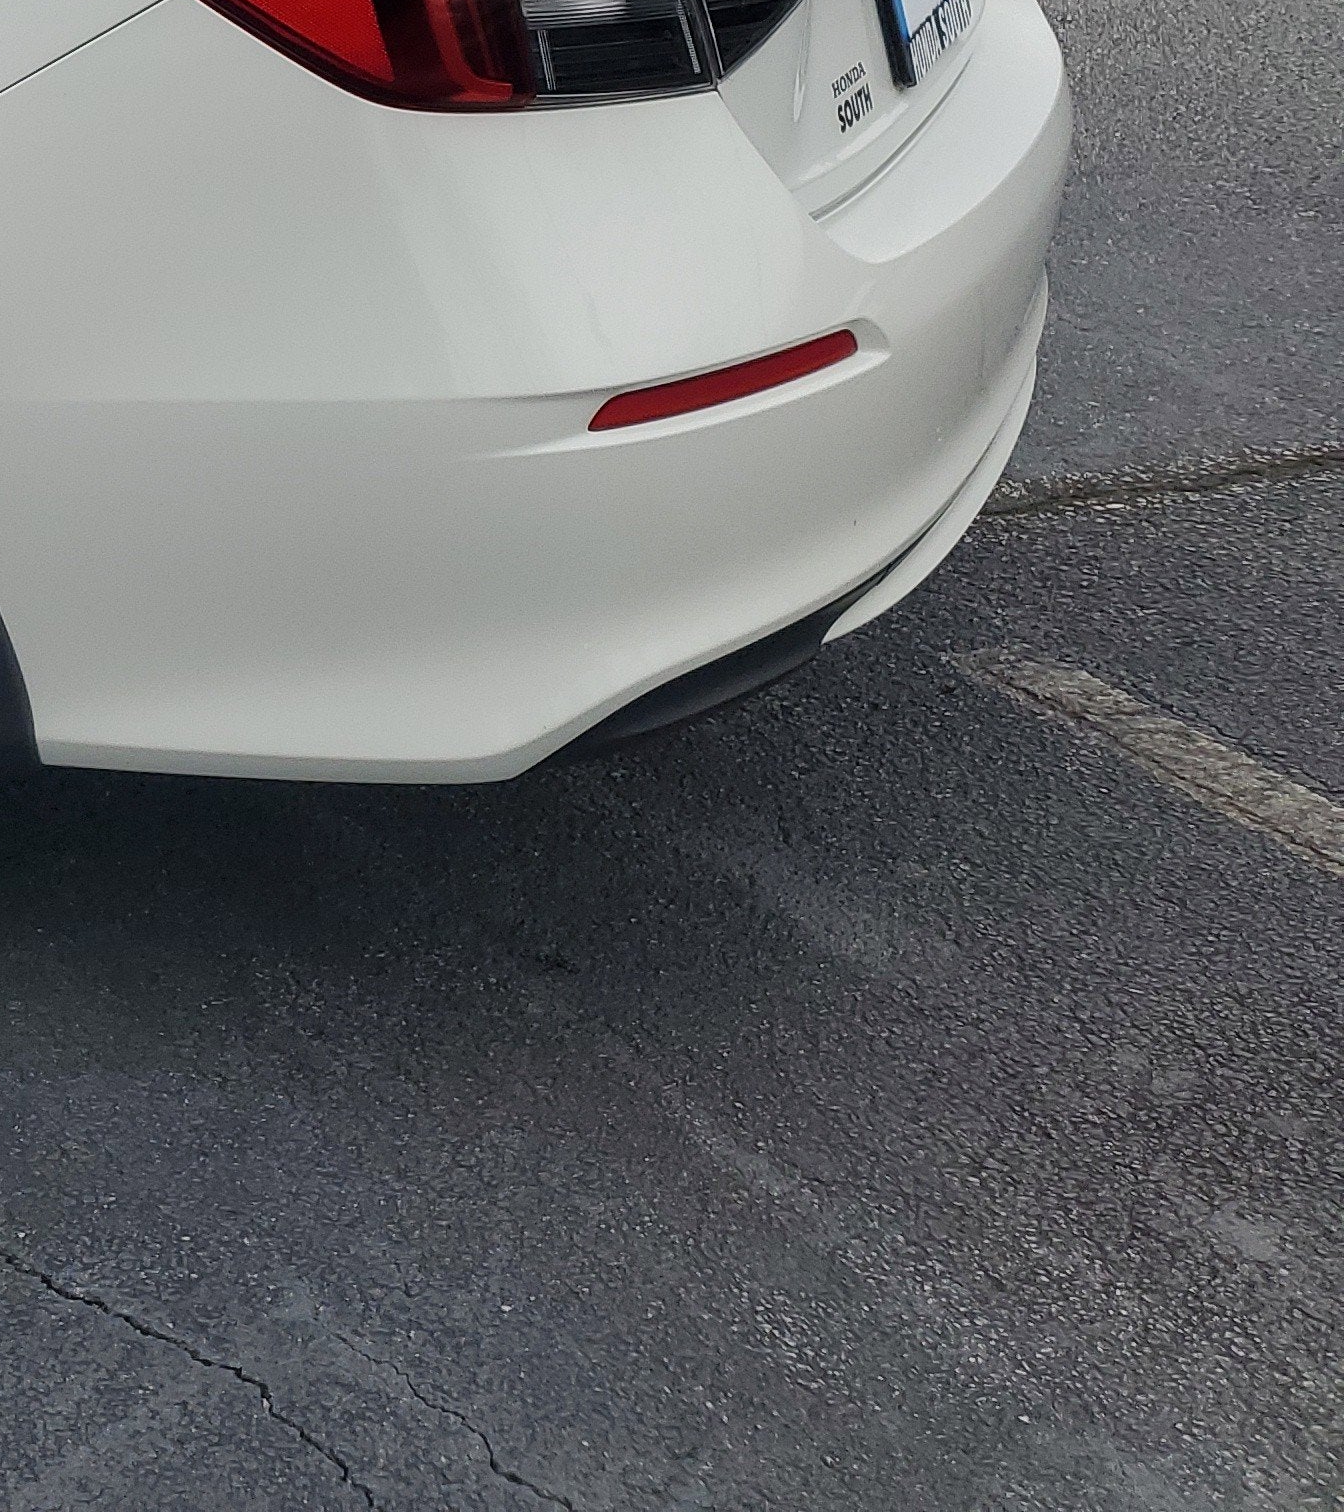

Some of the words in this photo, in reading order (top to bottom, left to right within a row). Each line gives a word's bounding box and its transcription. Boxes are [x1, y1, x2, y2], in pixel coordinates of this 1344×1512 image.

[909, 14, 942, 85] HONDA
[831, 61, 867, 99] HONDA
[837, 82, 874, 134] SOUTH
